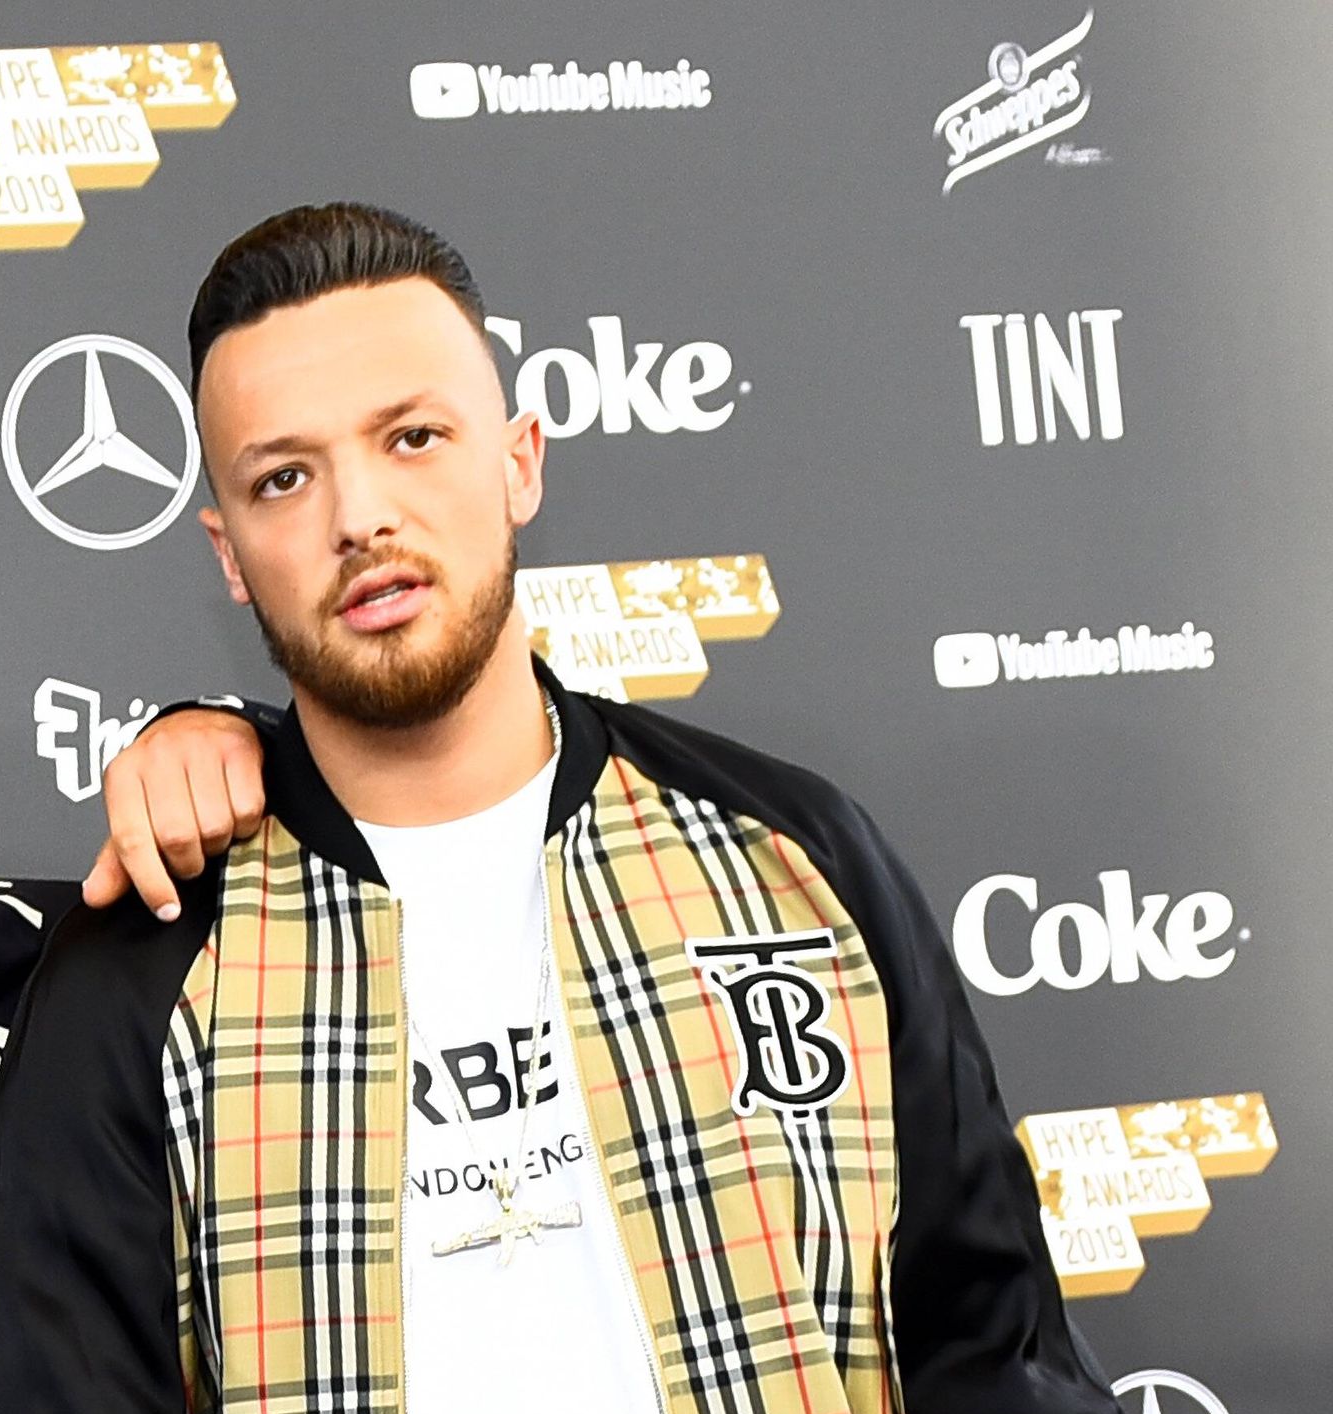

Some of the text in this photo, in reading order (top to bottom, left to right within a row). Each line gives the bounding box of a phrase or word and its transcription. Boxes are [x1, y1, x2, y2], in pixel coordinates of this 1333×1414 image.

[477, 59, 712, 114] YouTube Music
[11, 115, 141, 155] AWARDS
[945, 60, 1081, 167] Schweppes
[484, 314, 735, 439] oke
[959, 309, 1124, 447] TINT
[527, 576, 607, 616] HYPE
[571, 628, 690, 668] AWARDS
[996, 621, 1215, 681] YouTube Music
[952, 869, 1236, 996] Coke
[1041, 1119, 1116, 1160] HYPE
[1082, 1165, 1194, 1209] AWARDS
[1059, 1225, 1129, 1265] 2019
